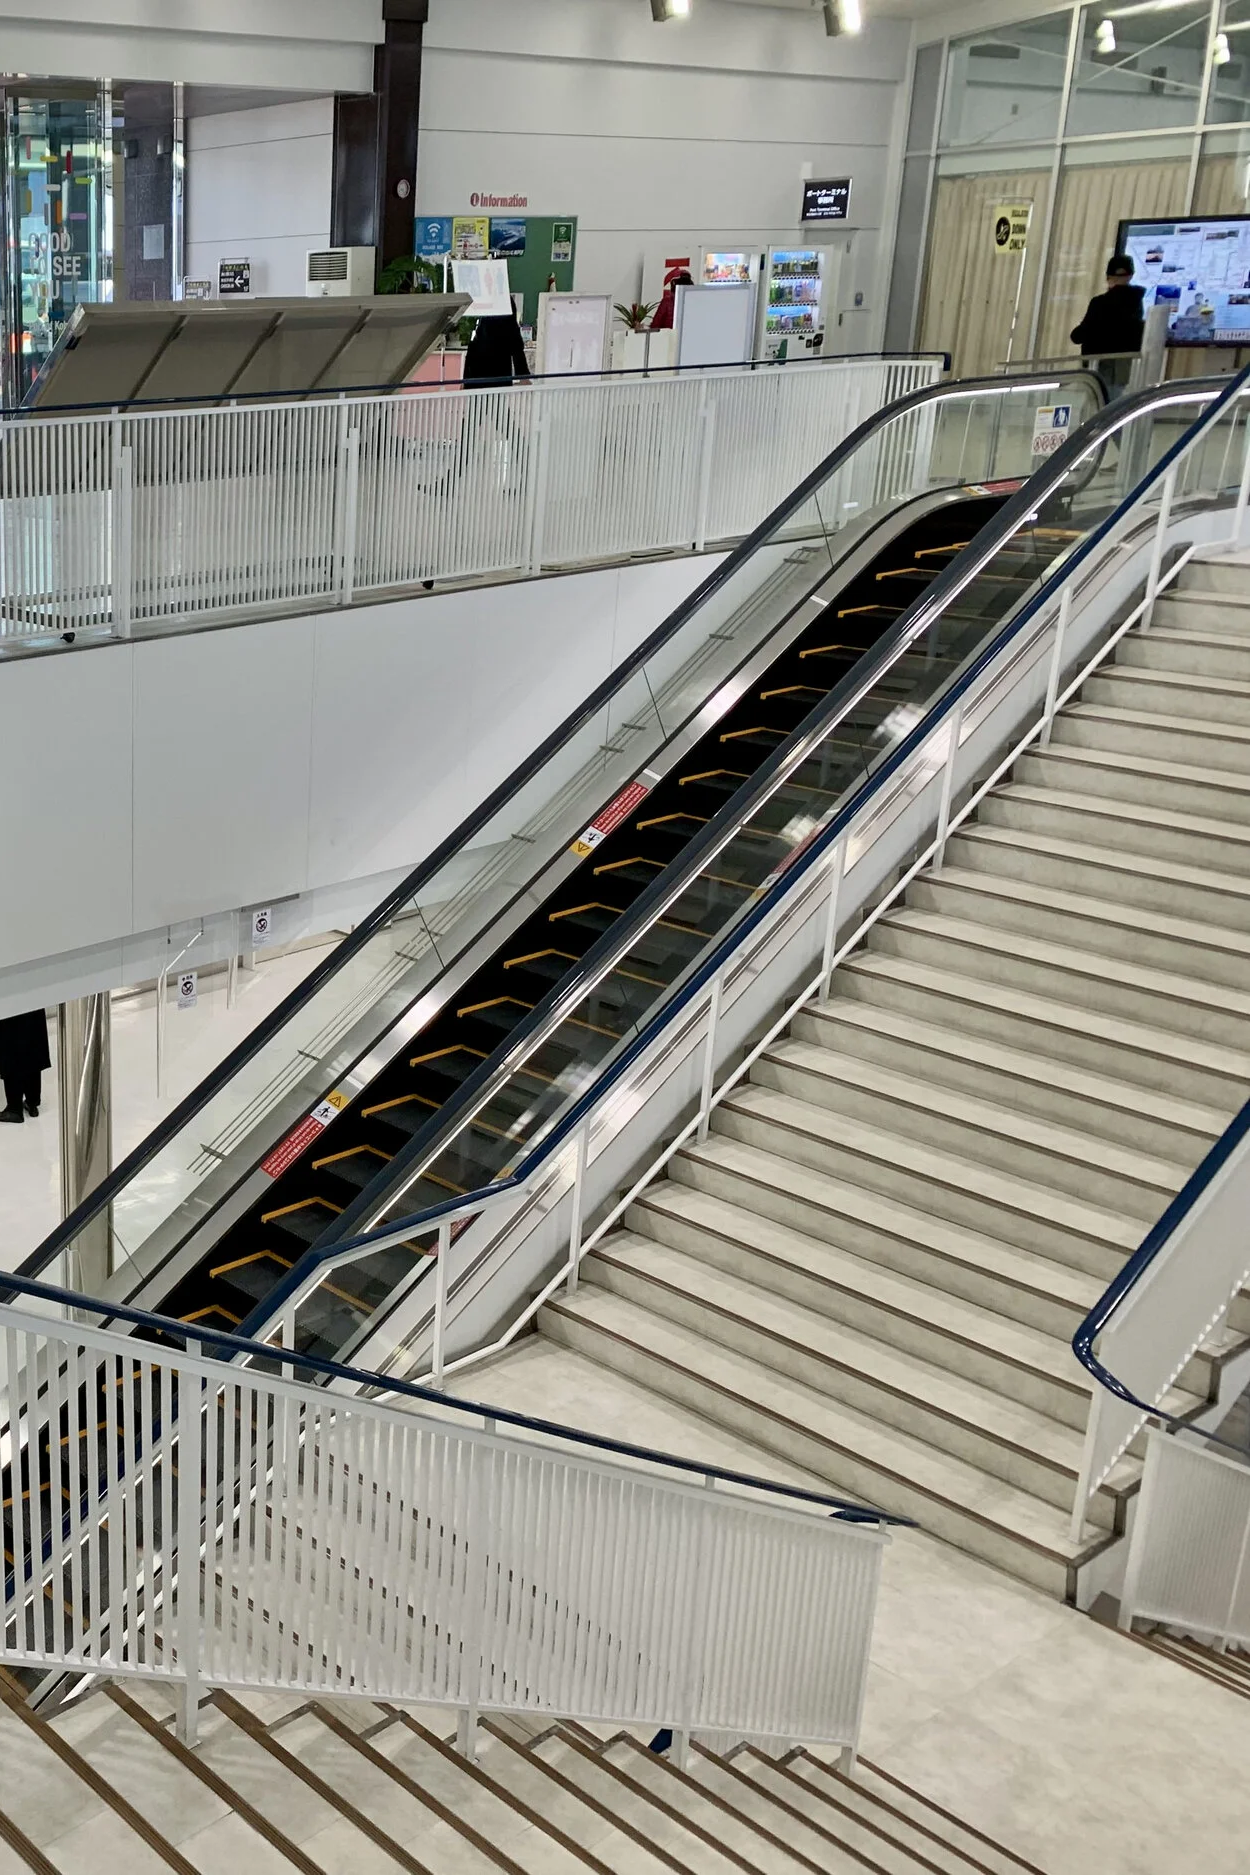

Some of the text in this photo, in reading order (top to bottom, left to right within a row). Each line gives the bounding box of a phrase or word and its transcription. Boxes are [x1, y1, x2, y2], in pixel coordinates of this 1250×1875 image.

[480, 193, 528, 208] Information
[29, 231, 72, 252] GOOD
[52, 255, 82, 276] SEE
